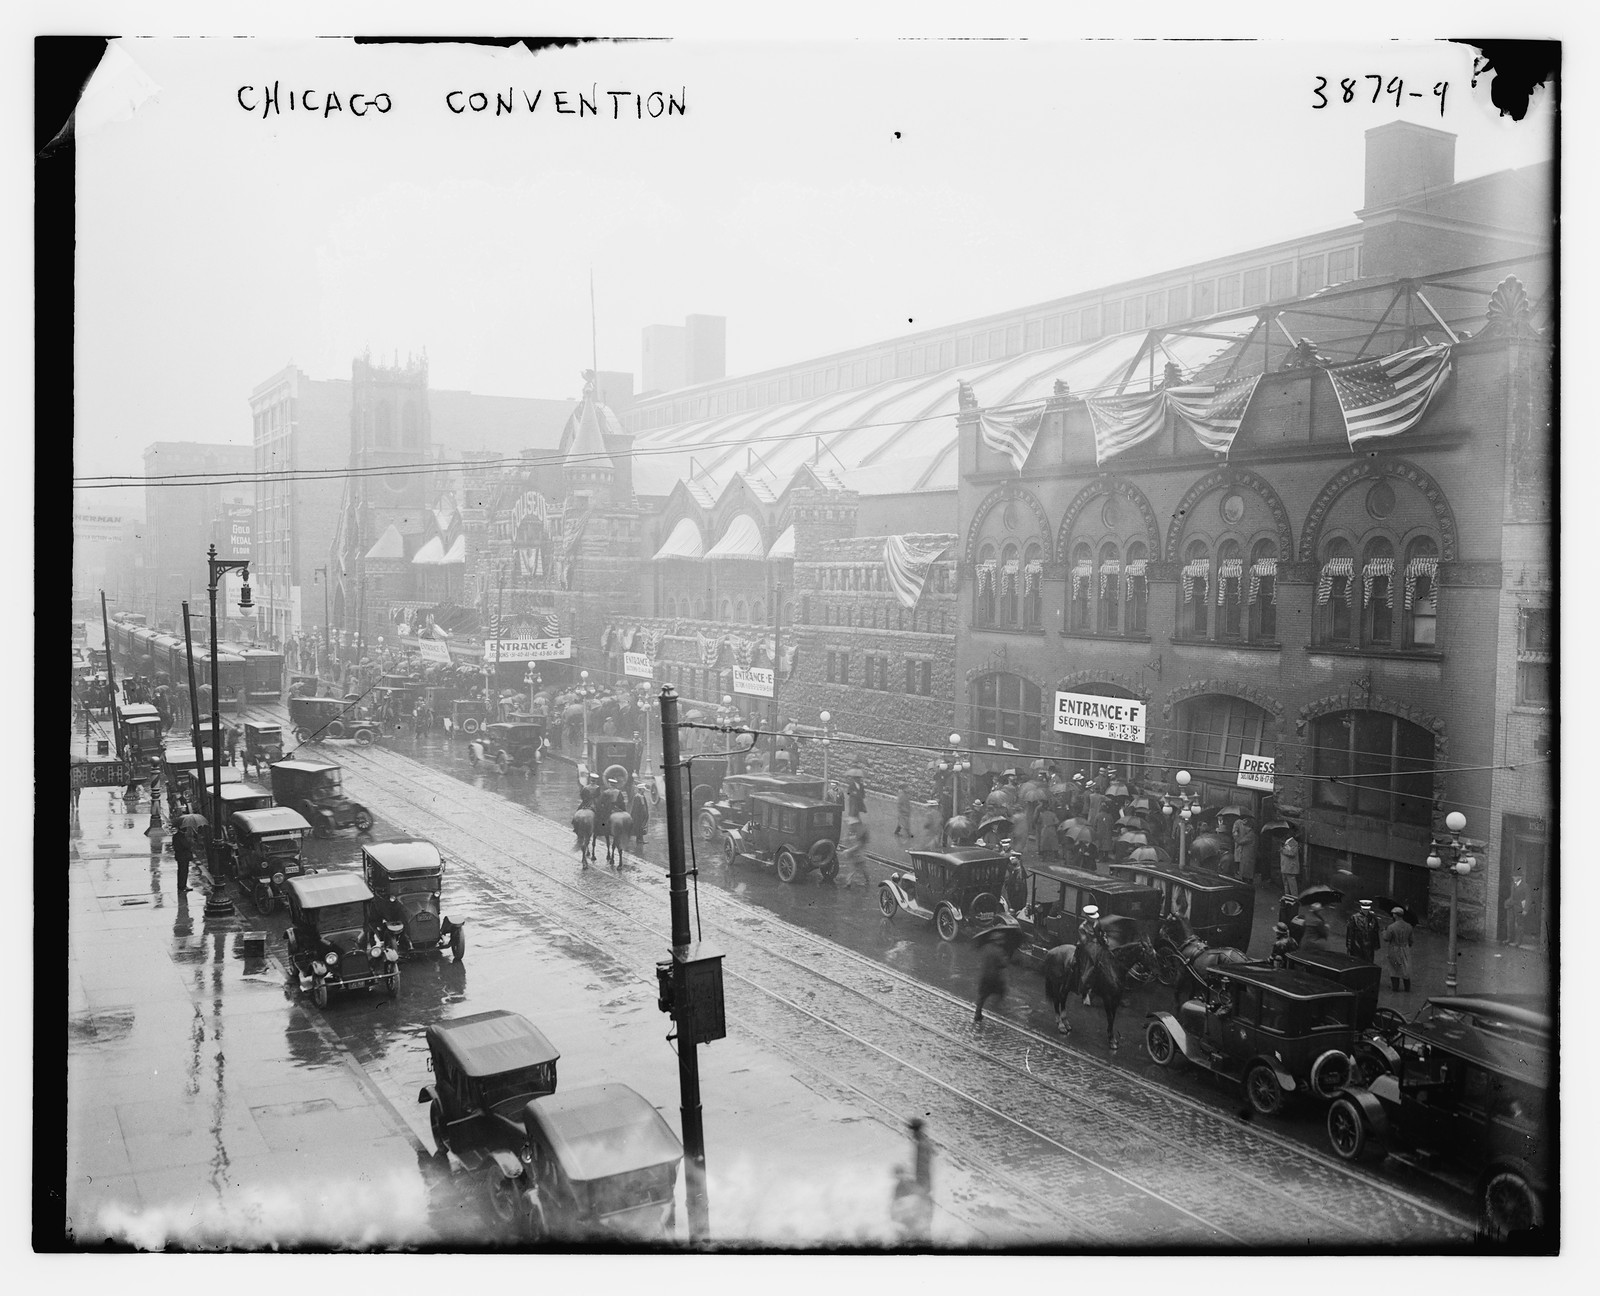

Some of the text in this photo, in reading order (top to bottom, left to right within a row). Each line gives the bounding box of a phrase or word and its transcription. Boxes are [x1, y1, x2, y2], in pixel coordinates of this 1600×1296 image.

[237, 80, 688, 119] CHICAGO CONVENTION
[1312, 74, 1449, 117] 3879-9
[232, 524, 250, 534] GOLD
[230, 535, 252, 545] MEDAL
[490, 642, 548, 651] ENTRANCE
[735, 670, 765, 683] ENTRANCE
[1059, 699, 1123, 720] ENTRANCE
[1059, 716, 1094, 728] SECTIONS
[1244, 760, 1275, 773] PRESS
